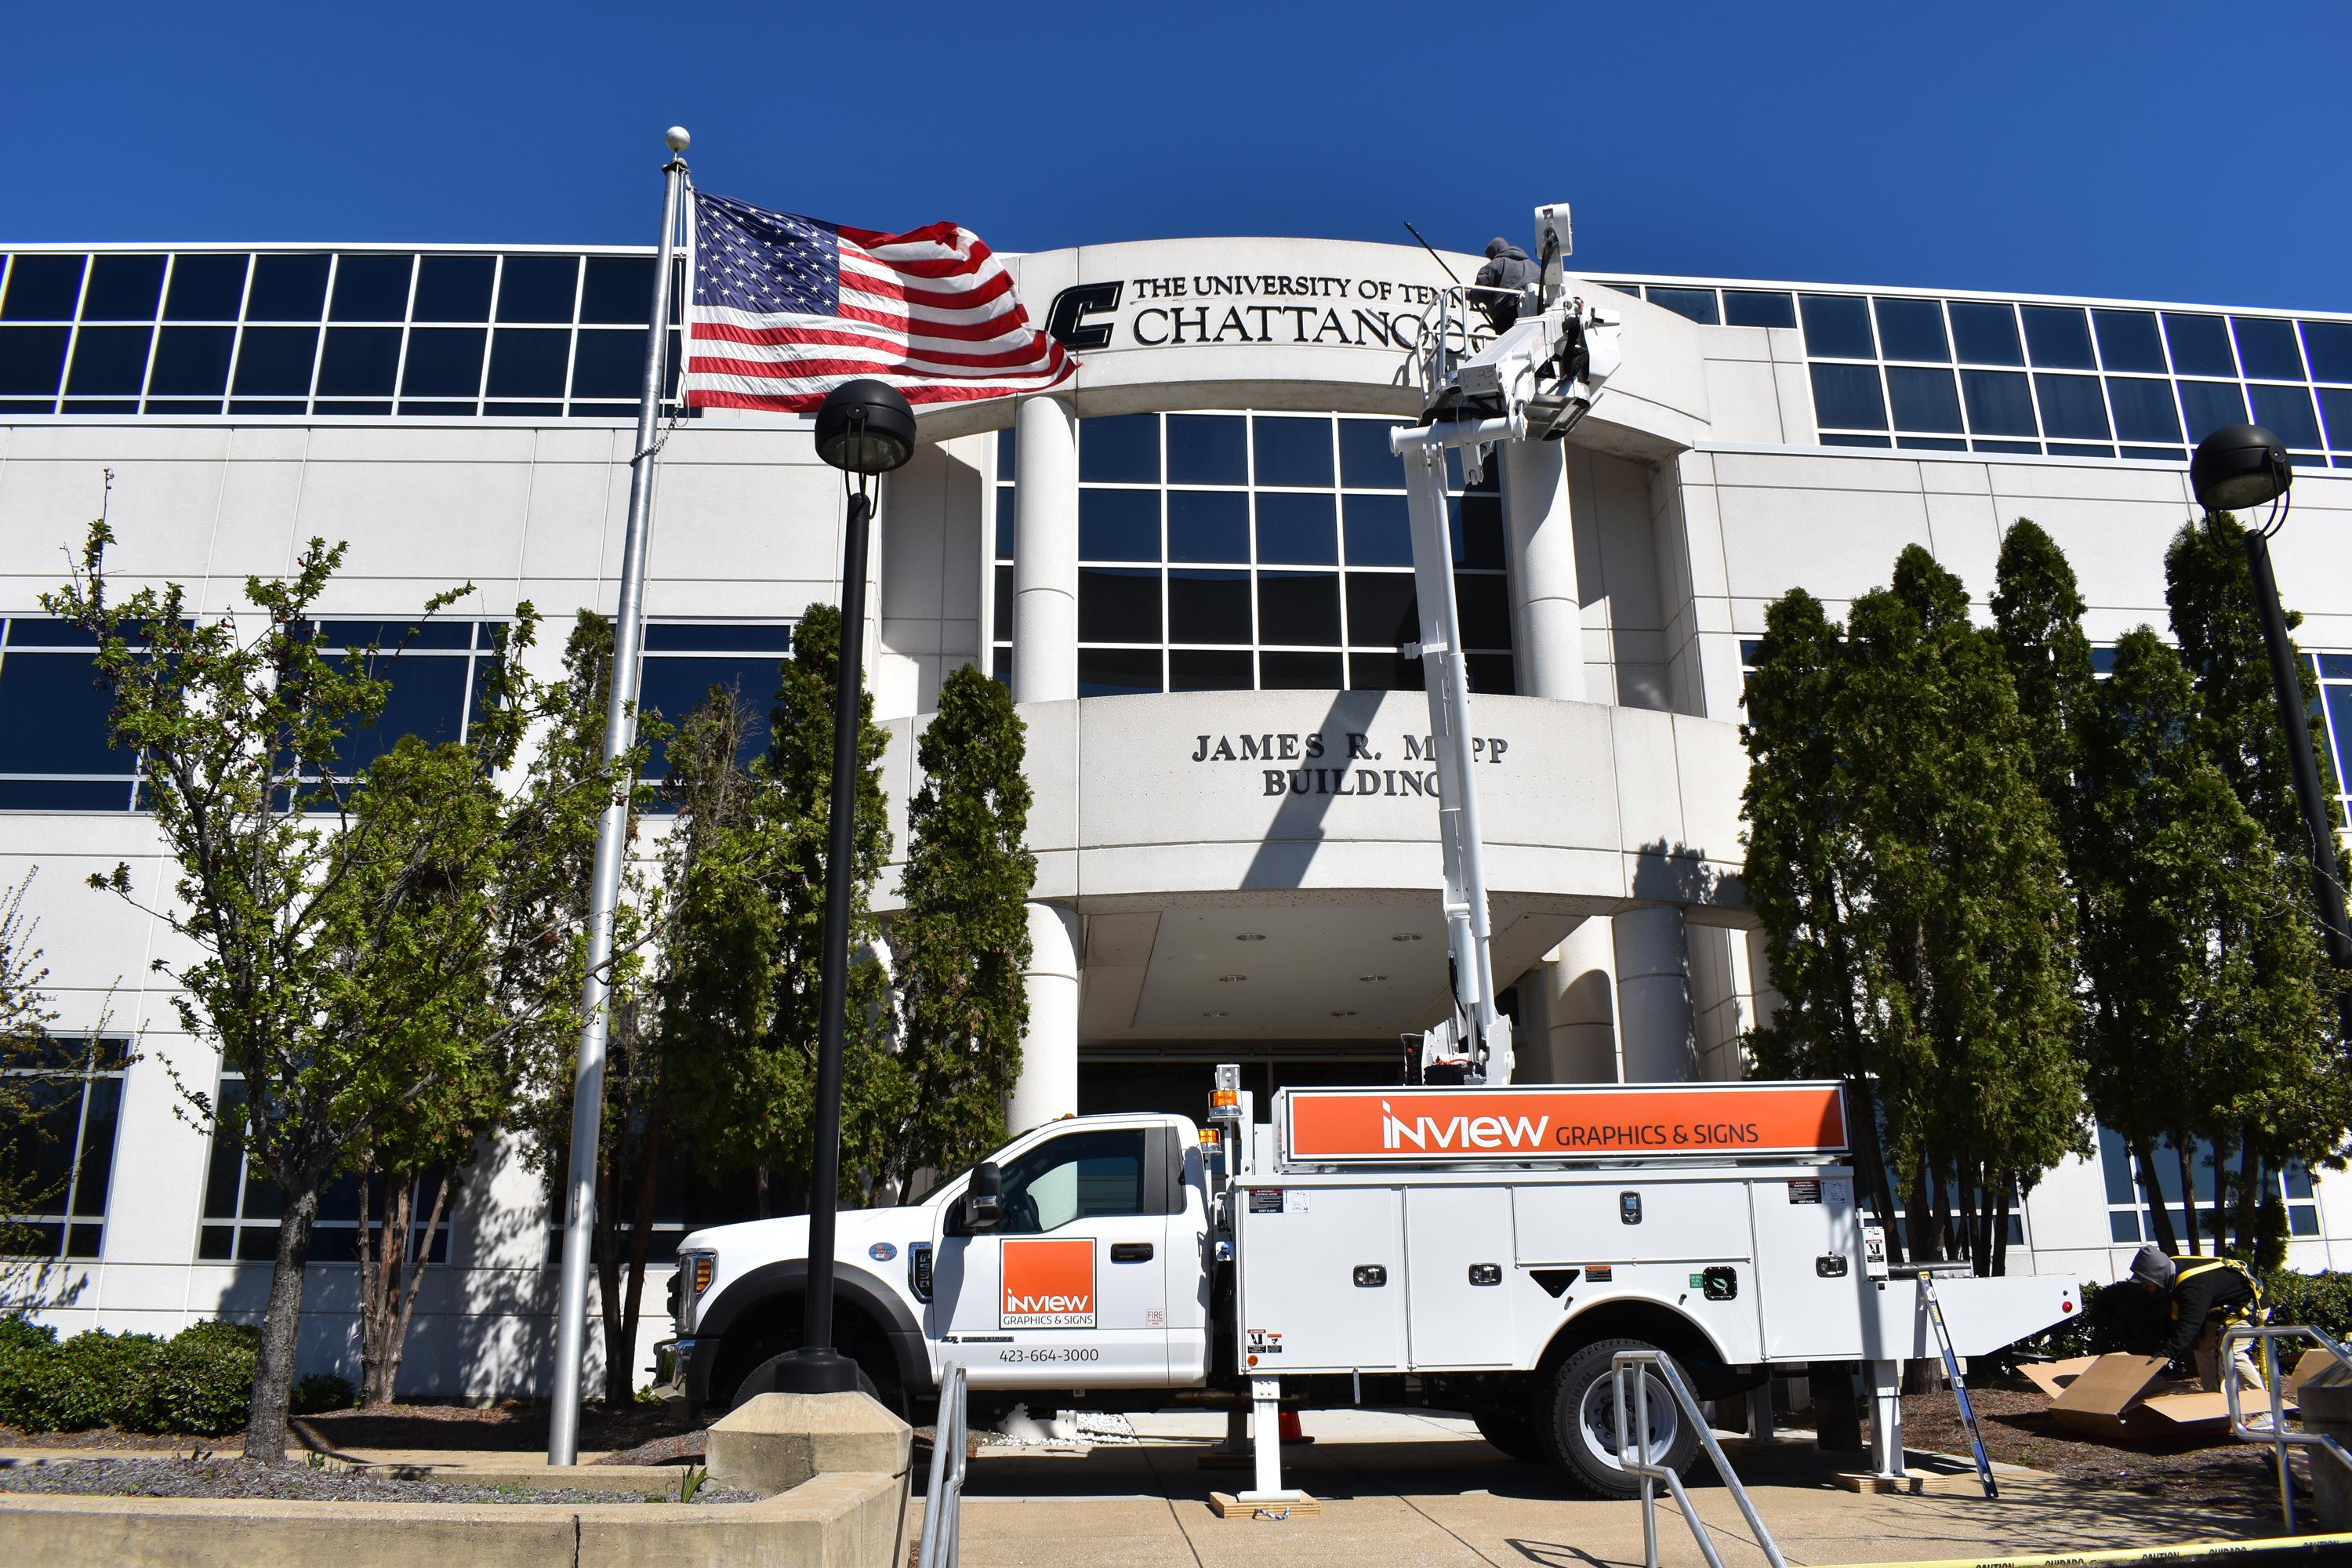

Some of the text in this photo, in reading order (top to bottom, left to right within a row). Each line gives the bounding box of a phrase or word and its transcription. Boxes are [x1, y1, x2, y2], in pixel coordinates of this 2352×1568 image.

[1132, 277, 1188, 299] THE
[1193, 275, 1352, 298] UNIVERSITY
[1358, 279, 1392, 300] OF
[1192, 733, 1508, 764] JAMES R. MPP
[1555, 1125, 1668, 1146] GRAPHICS
[1673, 1124, 1689, 1145] &
[1693, 1123, 1759, 1144] SIGNS
[1003, 1315, 1093, 1325] GRAPHICS & SIGNS
[1148, 1311, 1163, 1319] FIRE
[1000, 1348, 1099, 1363] 423-664-3000
